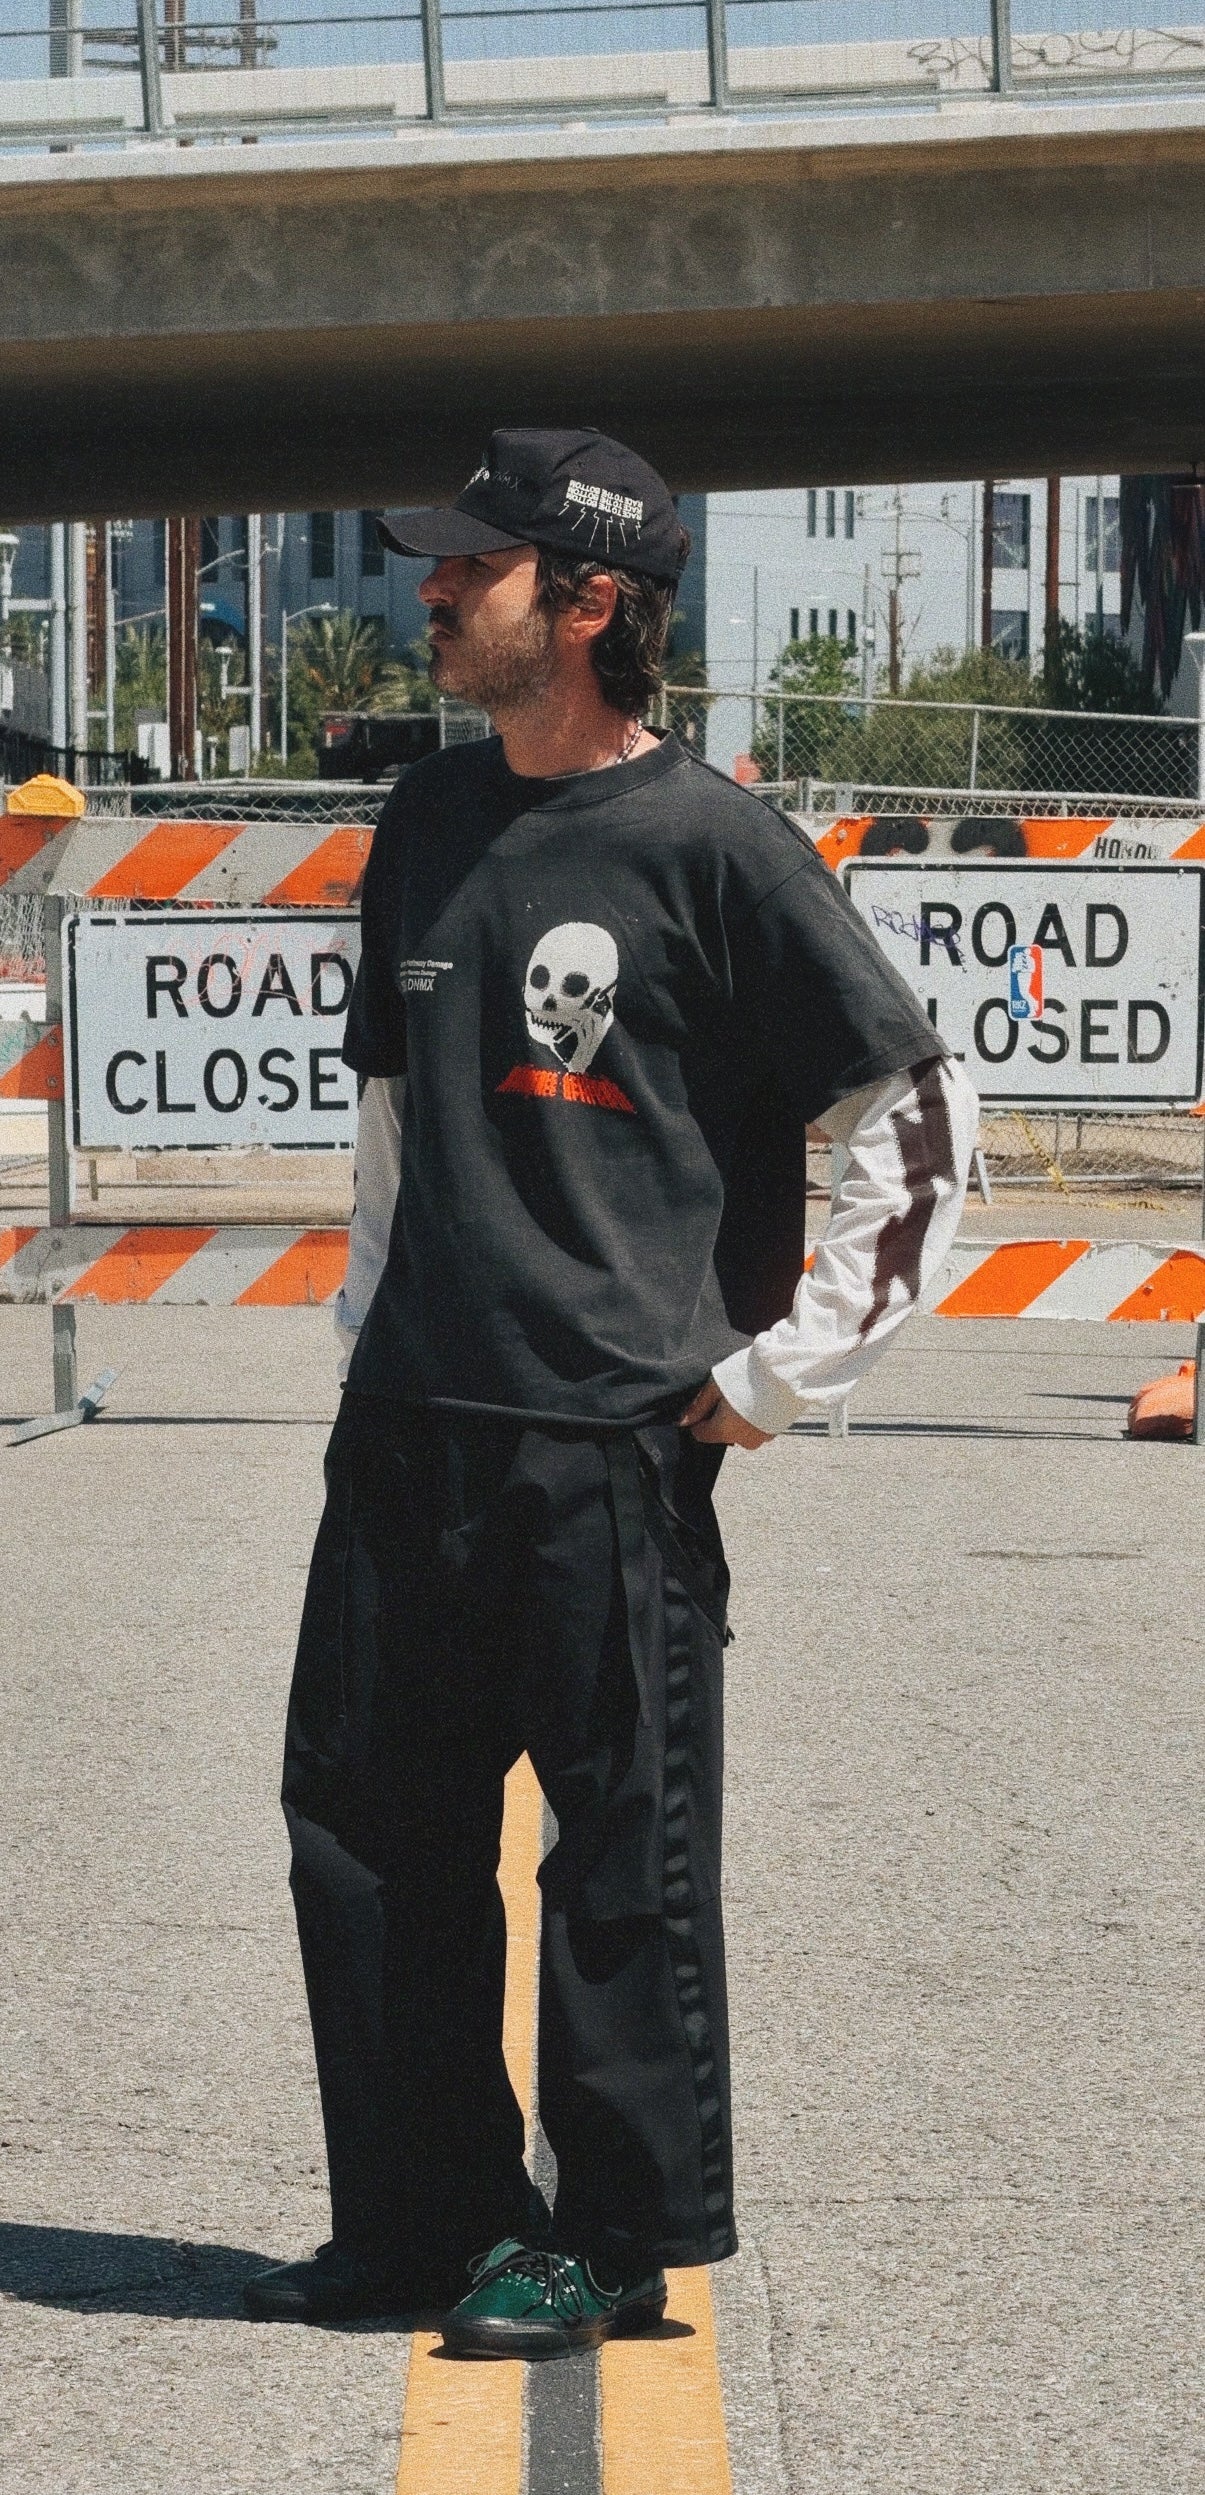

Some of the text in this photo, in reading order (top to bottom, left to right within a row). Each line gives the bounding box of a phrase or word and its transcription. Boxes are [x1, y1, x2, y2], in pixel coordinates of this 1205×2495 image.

[565, 493, 643, 521] RACE TO THE BOTTOM
[567, 486, 643, 514] RACE TO THE BOTTOM
[568, 479, 643, 507] RACE TO THE BOTTOM
[920, 901, 1129, 968] ROAD
[146, 953, 354, 1019] ROAD
[926, 997, 1171, 1064] LOSED
[106, 1047, 350, 1115] CLOSE
